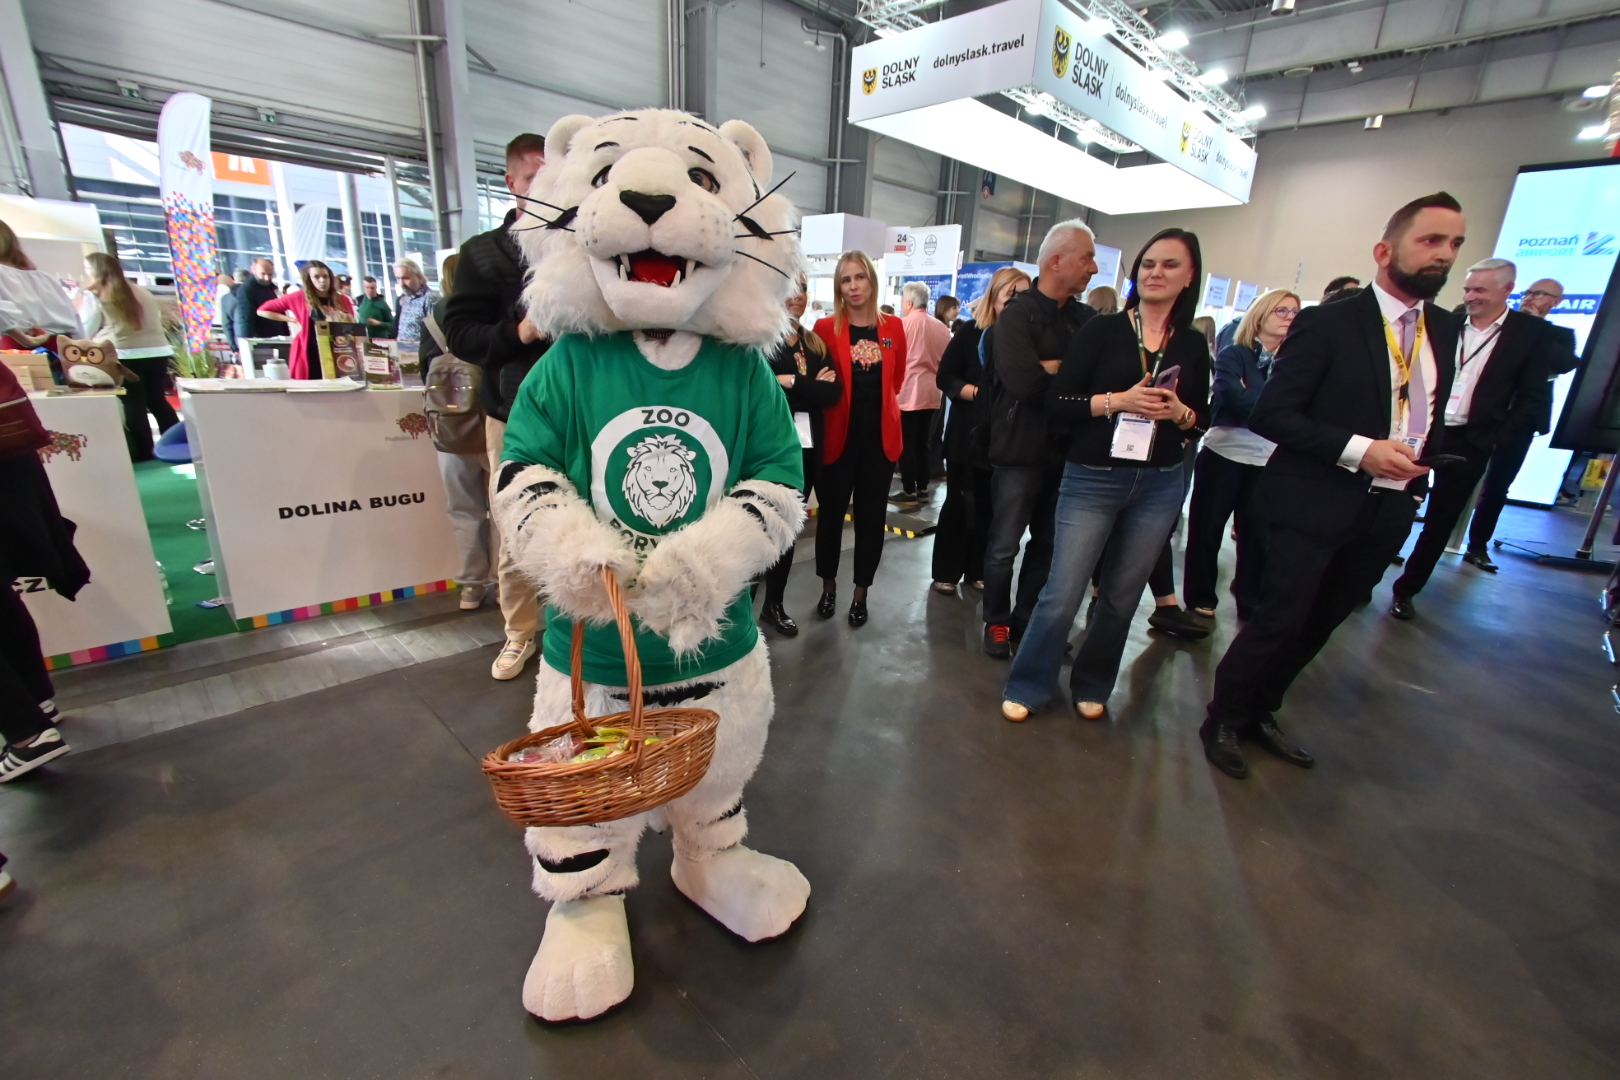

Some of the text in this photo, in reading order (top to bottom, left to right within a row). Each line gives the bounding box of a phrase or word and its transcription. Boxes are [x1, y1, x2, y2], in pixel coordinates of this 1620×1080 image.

[933, 34, 1025, 69] dolnyslask.travel
[1074, 42, 1109, 80] DOLNY
[882, 56, 920, 76] DOLNY
[881, 73, 916, 89] ŚLĄSK
[1071, 60, 1104, 100] ŚLĄSK
[1115, 82, 1168, 130] dolnyslask.travel
[1193, 127, 1214, 150] DOLNY
[897, 233, 907, 243] 24
[641, 408, 690, 427] ZOO
[278, 492, 425, 520] DOLINA BUGU
